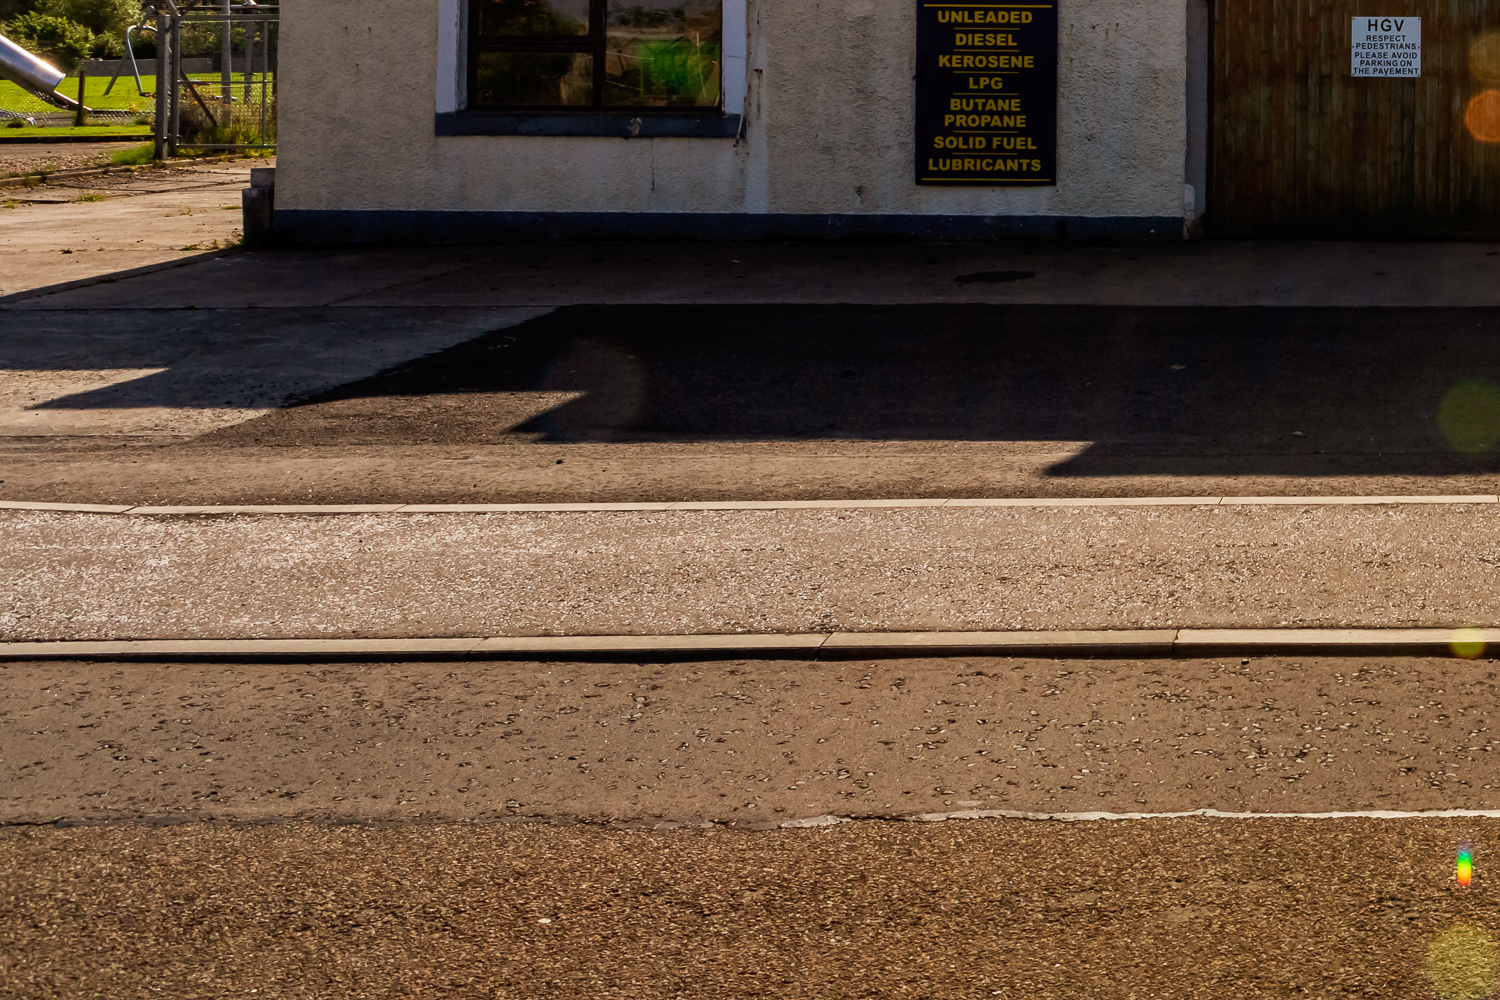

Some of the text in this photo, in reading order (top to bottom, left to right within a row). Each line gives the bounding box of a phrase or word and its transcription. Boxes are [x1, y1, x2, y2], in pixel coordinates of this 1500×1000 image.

[938, 11, 1032, 23] UNLEADED
[1368, 19, 1404, 31] HGV
[956, 34, 1017, 46] DIESEL
[939, 55, 1034, 68] KEROSENE
[1373, 67, 1419, 75] PAVEMENT
[969, 77, 1002, 89] LPG
[951, 99, 1020, 111] BUTANE
[945, 115, 1026, 127] PROPANE
[934, 136, 1036, 149] SOLID FUEL
[929, 159, 1041, 171] LUBRICANTS
